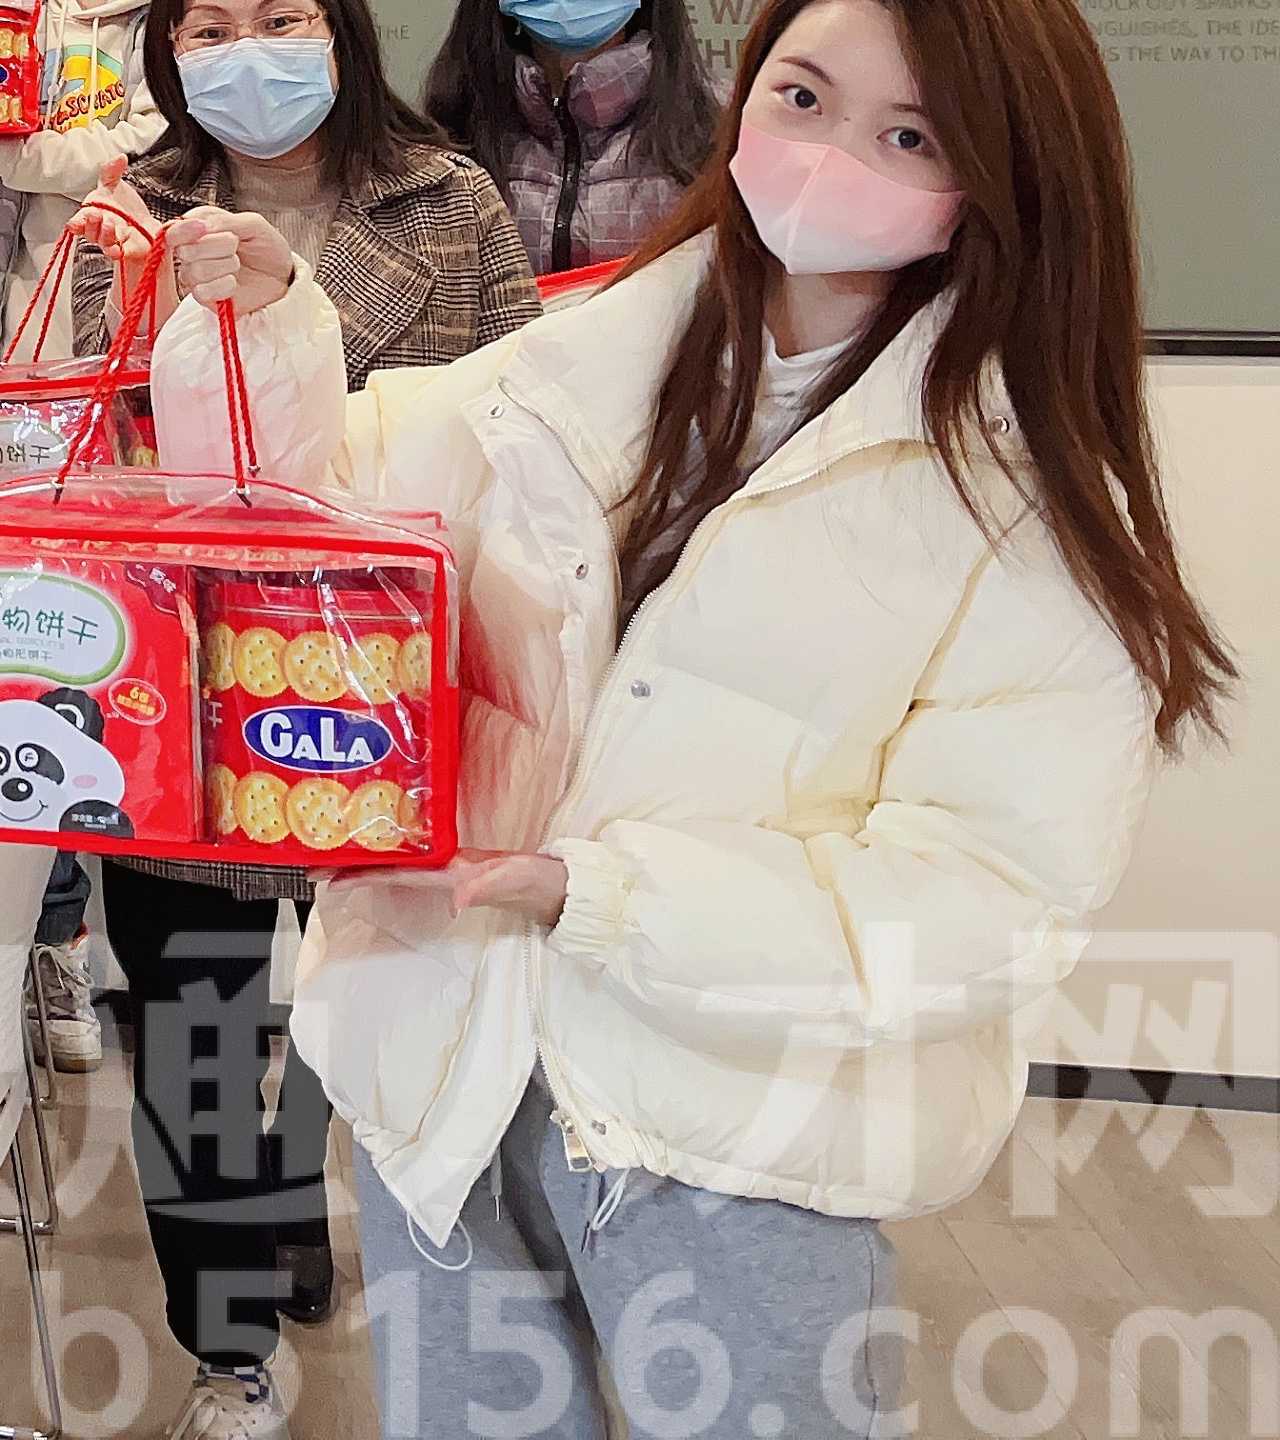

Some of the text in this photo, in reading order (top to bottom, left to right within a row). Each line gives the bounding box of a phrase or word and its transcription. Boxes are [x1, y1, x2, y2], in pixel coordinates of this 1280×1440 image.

[1206, 19, 1242, 37] THE
[1249, 18, 1280, 37] IDE
[1127, 46, 1161, 63] THE
[1169, 46, 1213, 62] WAY
[1216, 46, 1246, 63] TO
[259, 710, 376, 766] GALA
